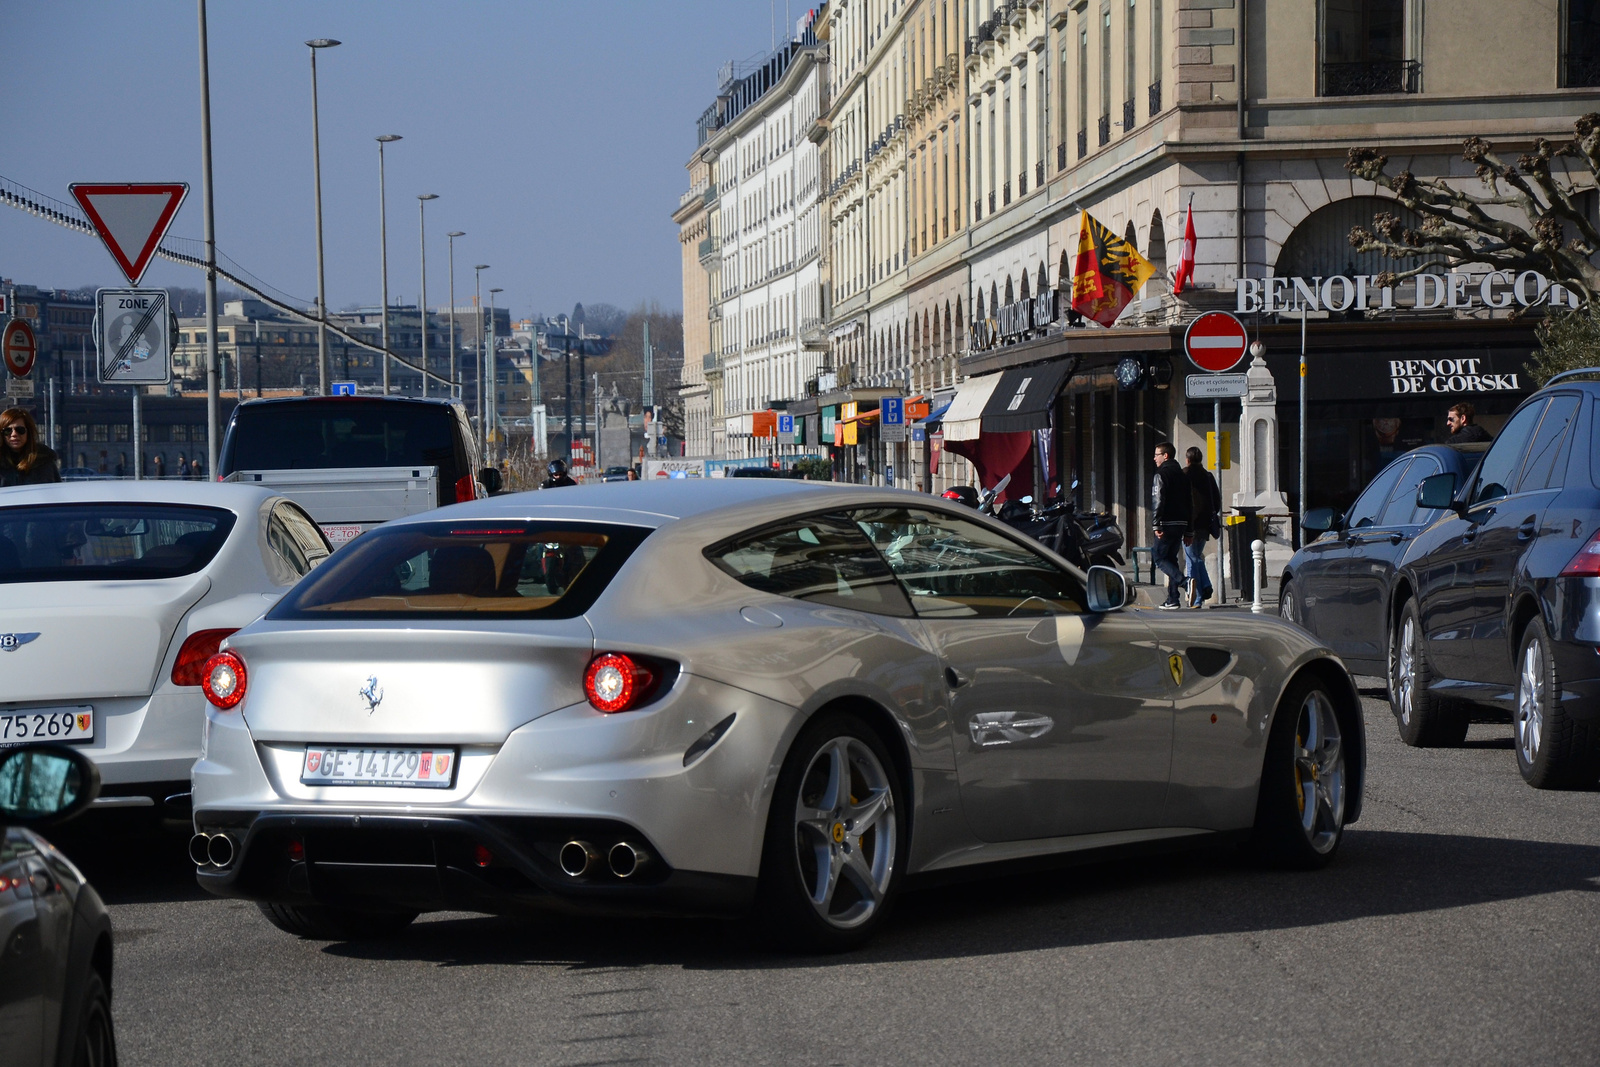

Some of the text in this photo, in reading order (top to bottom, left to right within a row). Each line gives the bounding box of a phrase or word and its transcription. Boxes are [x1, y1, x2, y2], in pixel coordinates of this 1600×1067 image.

[1234, 275, 1402, 314] BENOIT
[1413, 272, 1473, 310] DE
[118, 299, 149, 309] ZONE
[1389, 358, 1480, 376] BENOIT
[1391, 374, 1521, 393] DE GORSKI
[889, 400, 897, 412] P
[783, 417, 790, 427] P
[422, 759, 430, 772] 10
